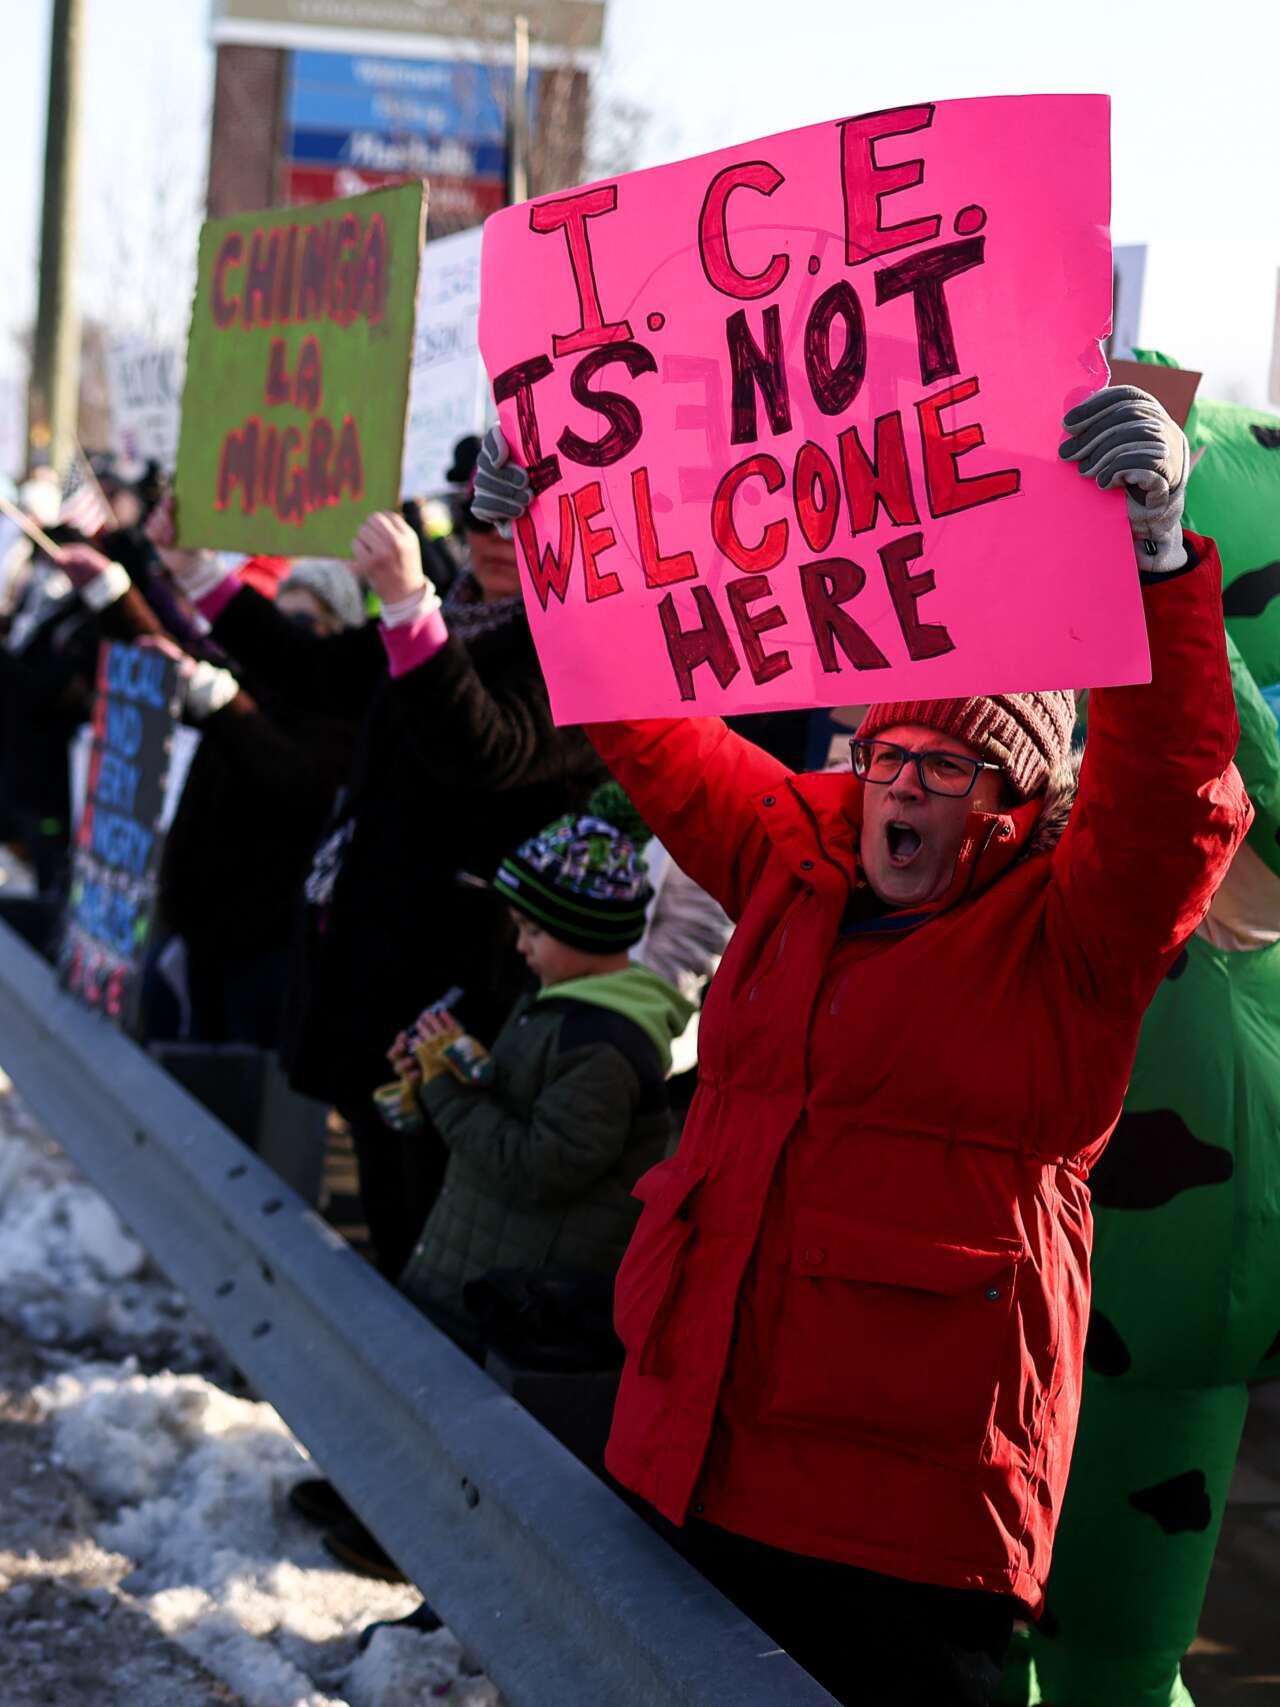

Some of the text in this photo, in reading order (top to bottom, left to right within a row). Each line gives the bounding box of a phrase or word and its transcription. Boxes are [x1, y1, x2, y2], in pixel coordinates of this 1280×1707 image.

[210, 212, 387, 333] CHINGA
[263, 335, 322, 414] LA
[493, 340, 658, 497] IS
[726, 236, 985, 446] NOT
[215, 415, 365, 528] MIGRA
[518, 376, 1021, 611] WELCOME
[658, 532, 956, 701] HERE
